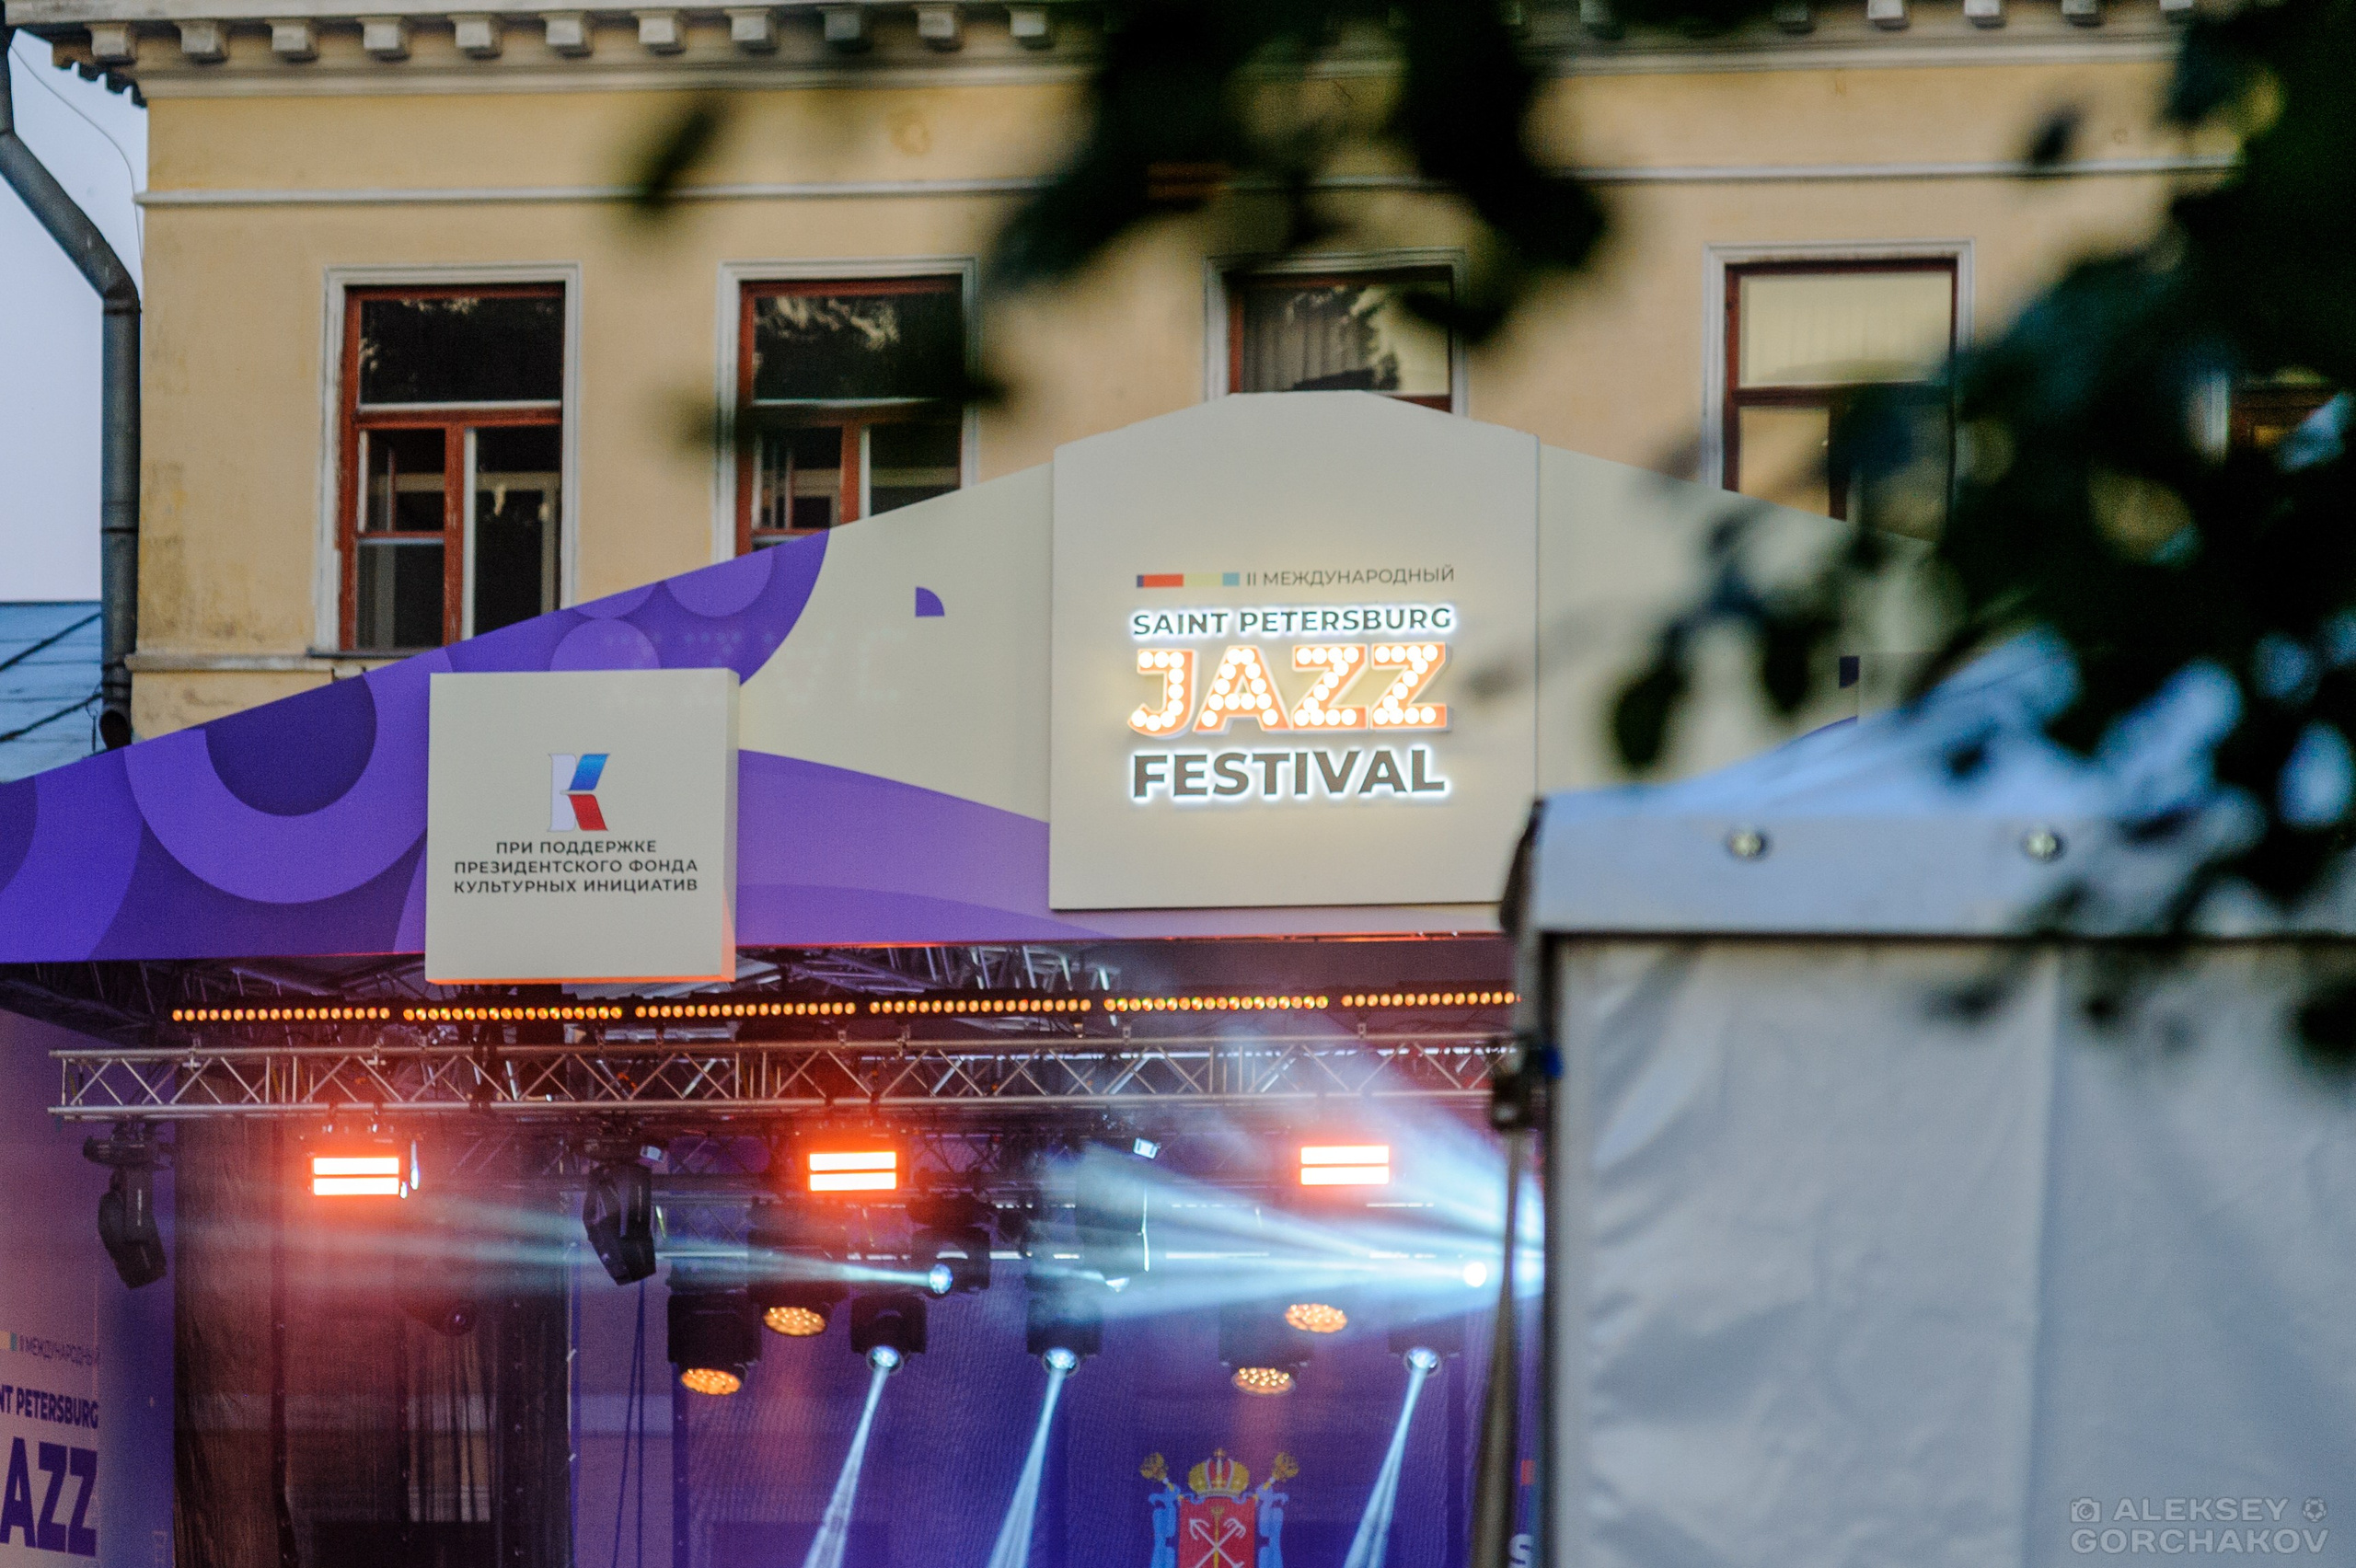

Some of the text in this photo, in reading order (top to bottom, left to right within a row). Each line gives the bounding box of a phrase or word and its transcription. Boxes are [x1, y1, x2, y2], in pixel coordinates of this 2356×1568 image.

[1264, 564, 1455, 587] МЕЖДУНАРОДНЫЙ
[1133, 607, 1451, 636] SAINT PETERSBURG
[1127, 643, 1449, 735] JAZZ
[1133, 749, 1446, 799] FESTIVAL
[496, 839, 656, 855] ПРИ ПОДДЕРЖКЕ
[455, 859, 698, 875] ПРЕЗИДЕНТСКОГО ФОНДА
[454, 879, 698, 894] КУЛЬТУРНЫХ ИНИЦИАТИВ
[17, 1387, 98, 1429] PETERSBURG
[0, 1436, 98, 1557] AZZ
